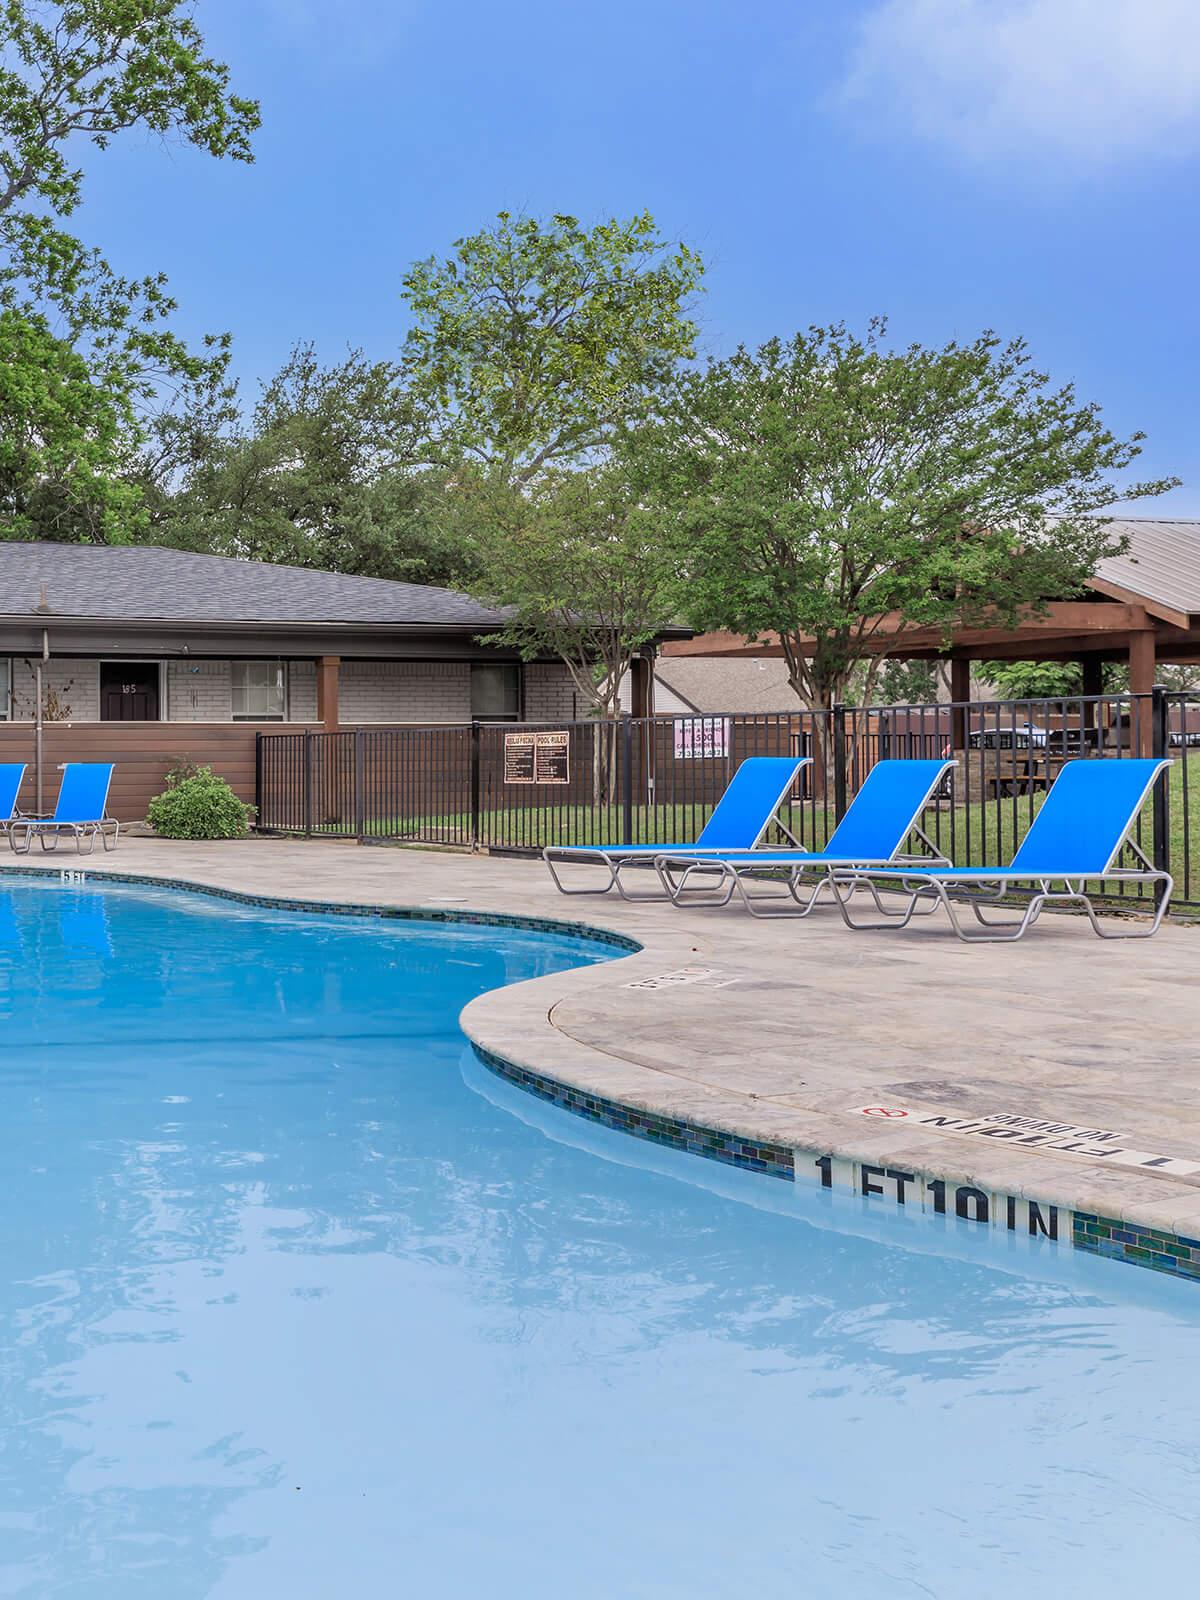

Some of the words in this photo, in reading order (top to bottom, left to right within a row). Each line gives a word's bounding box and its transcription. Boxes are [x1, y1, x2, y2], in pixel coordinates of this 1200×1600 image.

[537, 736, 550, 744] POOL
[551, 735, 566, 744] RULES
[919, 1116, 981, 1130] IN
[984, 1114, 1076, 1134] DIVING
[979, 1128, 1048, 1144] 10
[1073, 1130, 1121, 1142] NO
[1048, 1142, 1123, 1157] FT
[1140, 1157, 1173, 1168] 1
[815, 1156, 832, 1188] 1
[861, 1164, 915, 1205] FT
[927, 1179, 989, 1224] 10
[1007, 1195, 1058, 1241] IN
